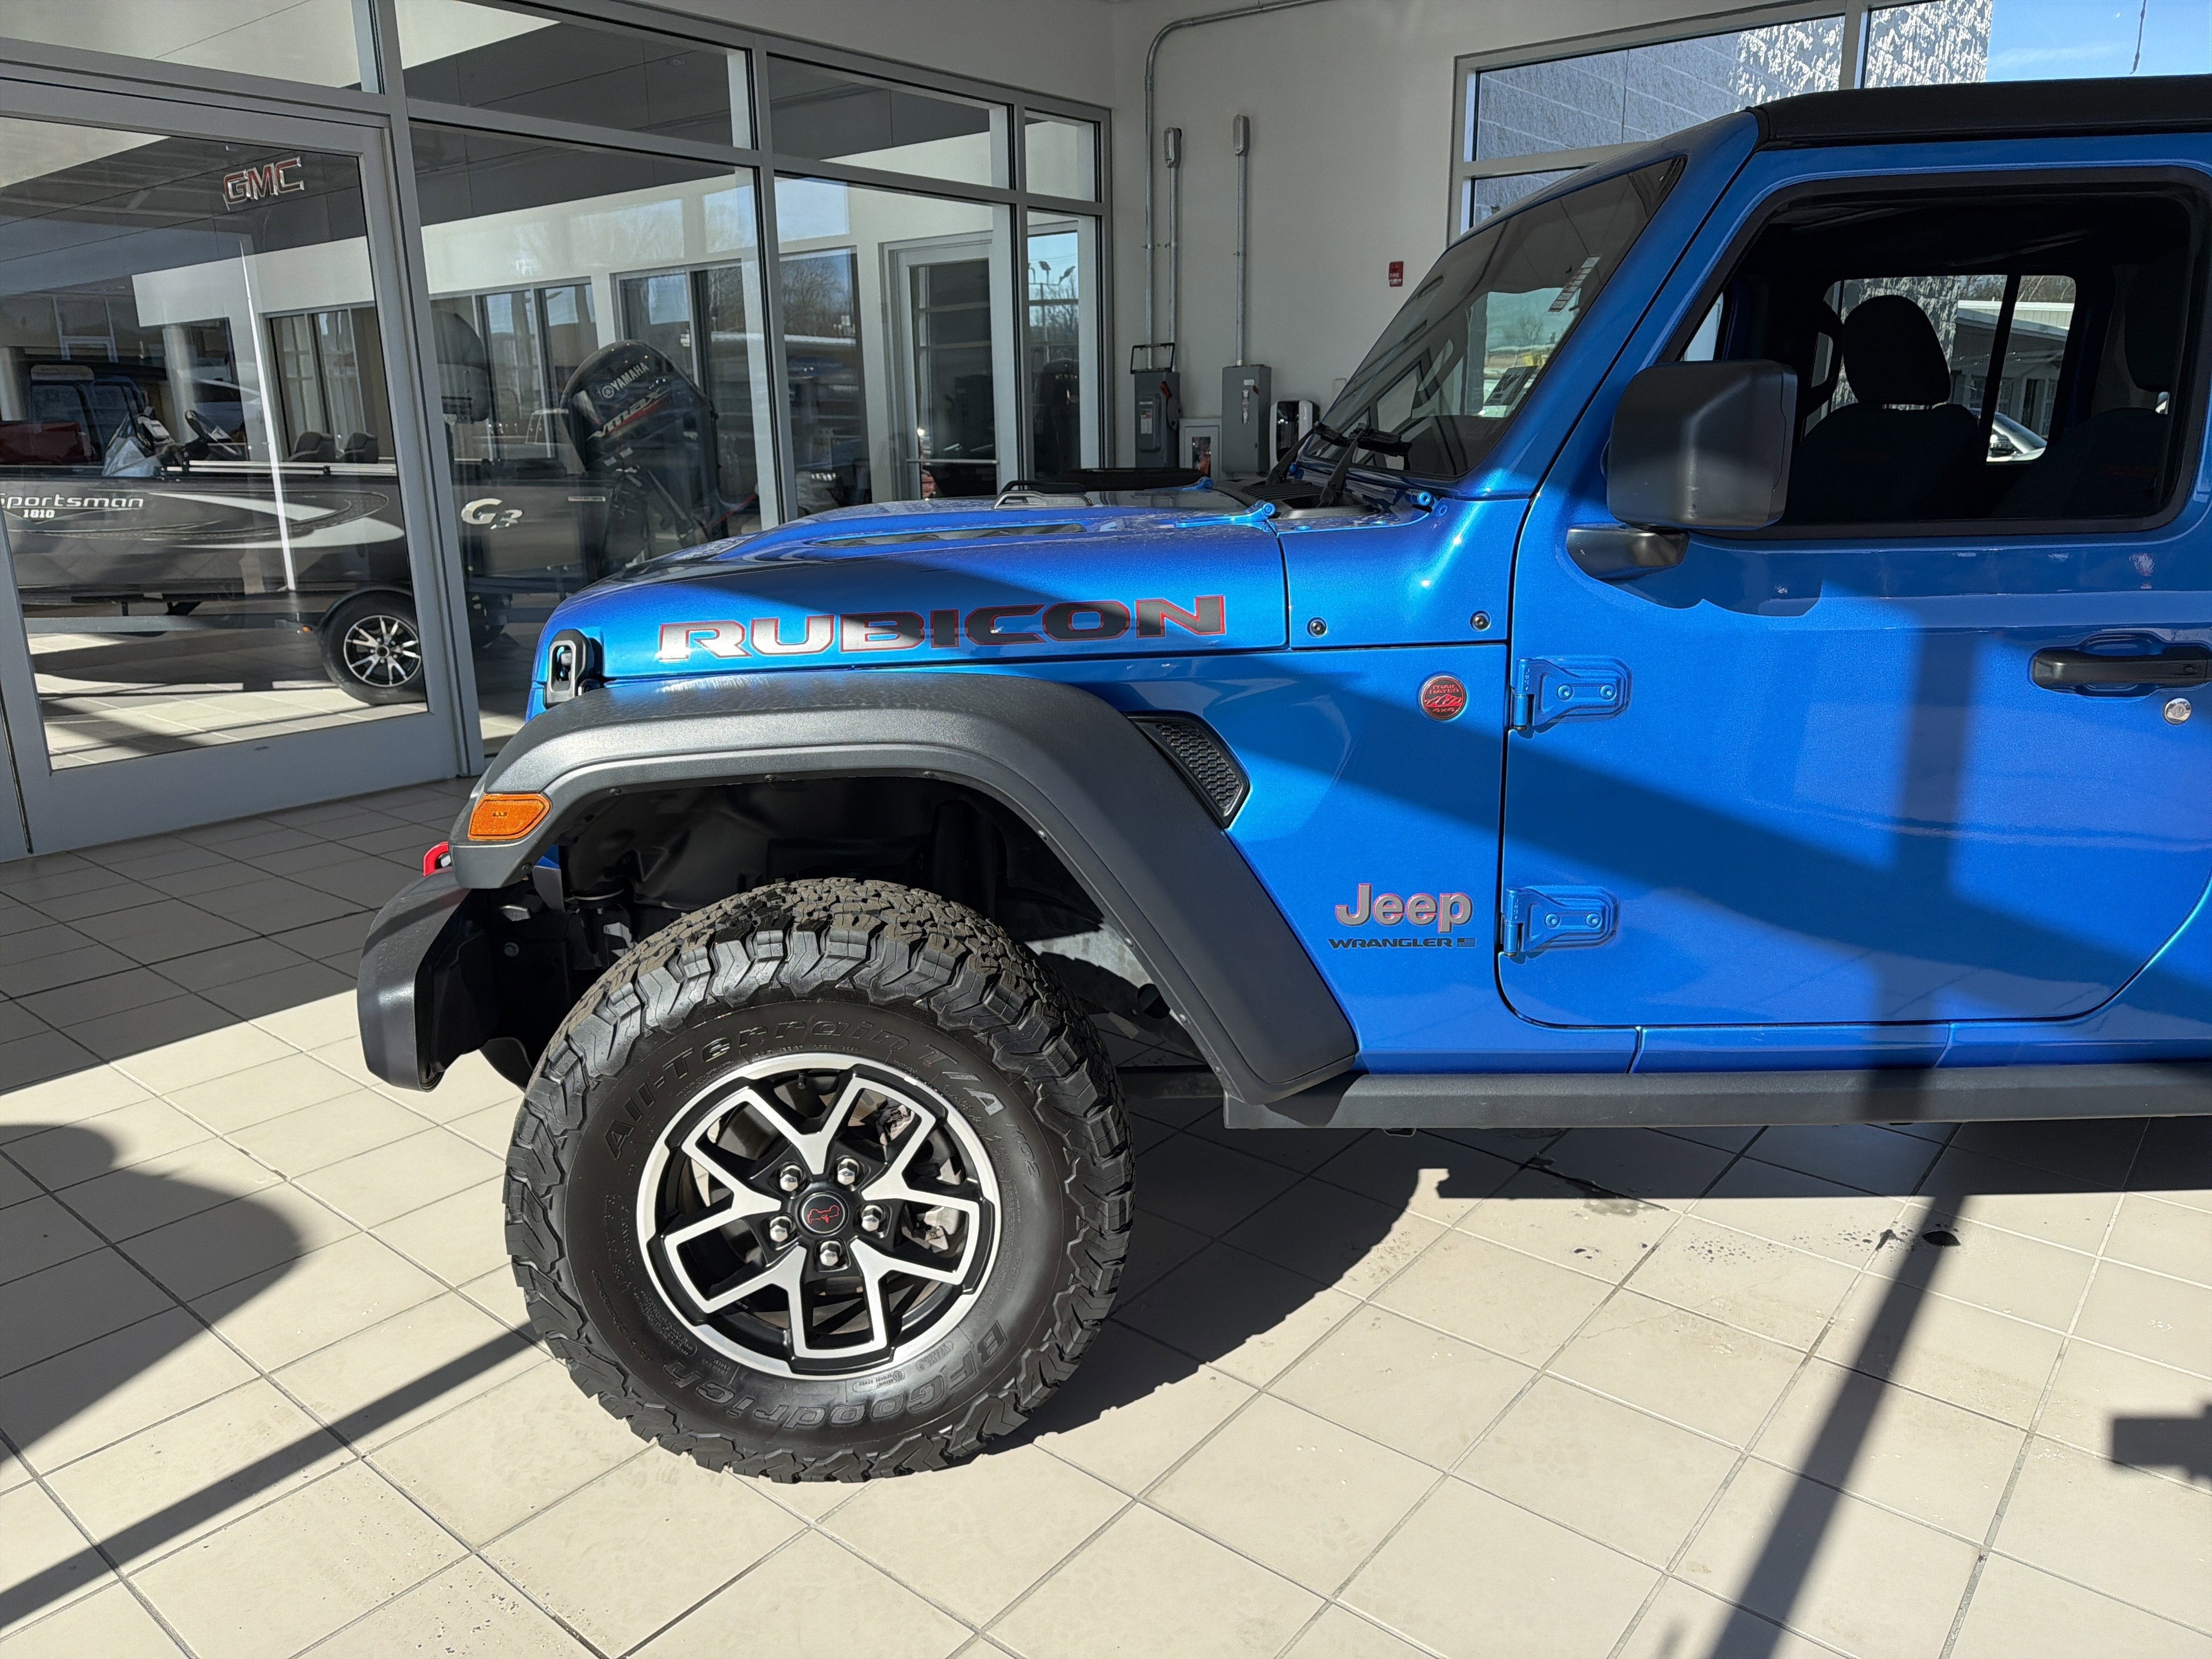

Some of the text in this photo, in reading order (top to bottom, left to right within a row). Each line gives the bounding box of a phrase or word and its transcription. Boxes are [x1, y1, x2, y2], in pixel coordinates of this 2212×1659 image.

[223, 156, 305, 205] GMC
[610, 362, 650, 391] YAMAHA
[23, 509, 55, 518] 1810
[461, 498, 524, 530] G3
[658, 595, 1226, 661] RUBICON
[1335, 883, 1472, 933] Jeep
[1328, 938, 1453, 949] WRANGLER
[604, 1020, 911, 1161] All-Terrain
[918, 1043, 1006, 1116] T/A
[663, 1318, 1008, 1430] BFGoodrich
